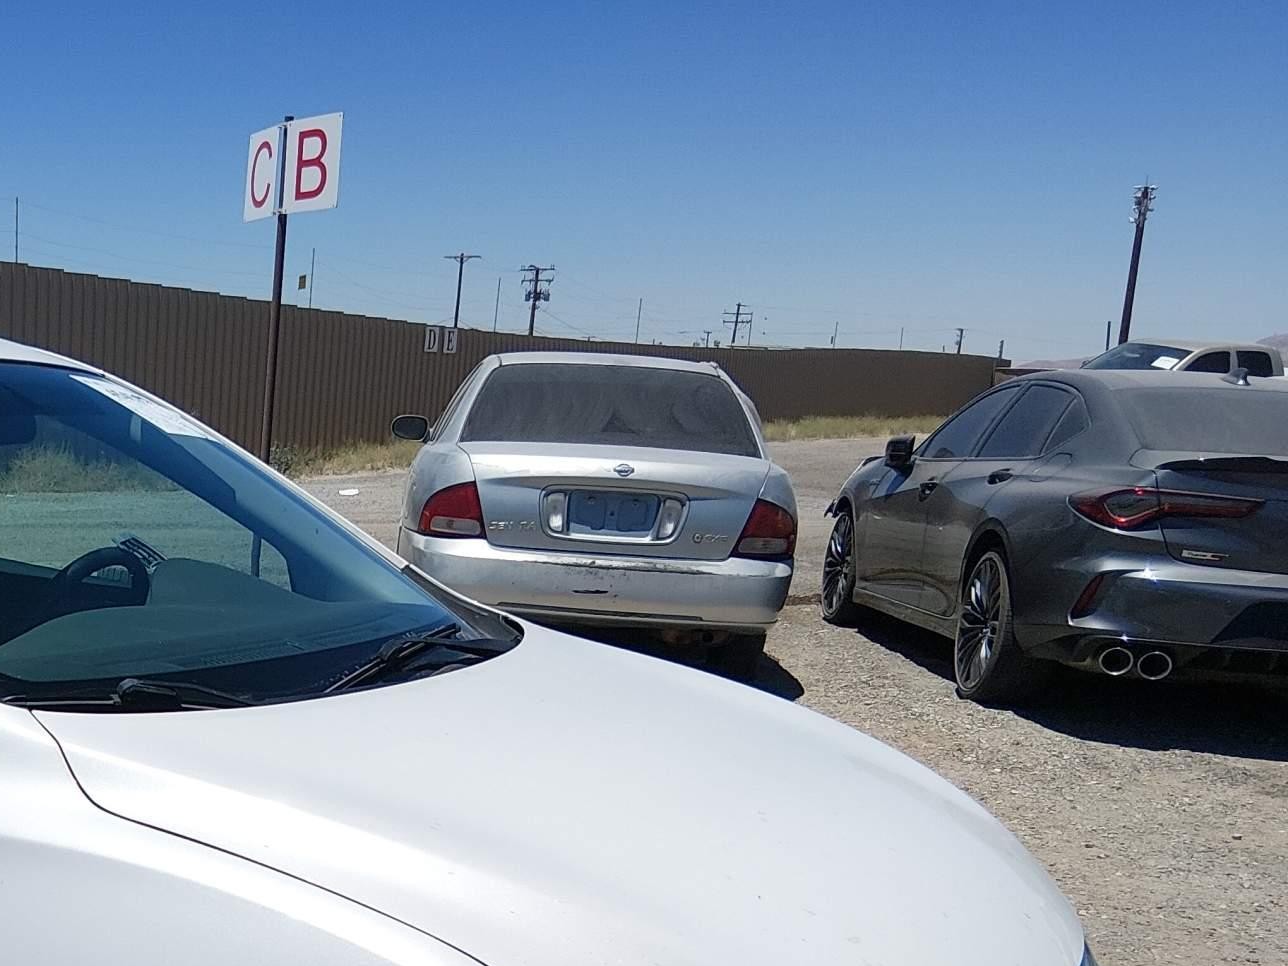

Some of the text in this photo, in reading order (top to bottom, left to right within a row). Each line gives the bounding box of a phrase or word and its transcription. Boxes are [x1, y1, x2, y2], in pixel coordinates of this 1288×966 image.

[250, 140, 273, 208] C
[294, 128, 328, 201] B
[427, 329, 437, 350] D
[446, 330, 455, 352] E
